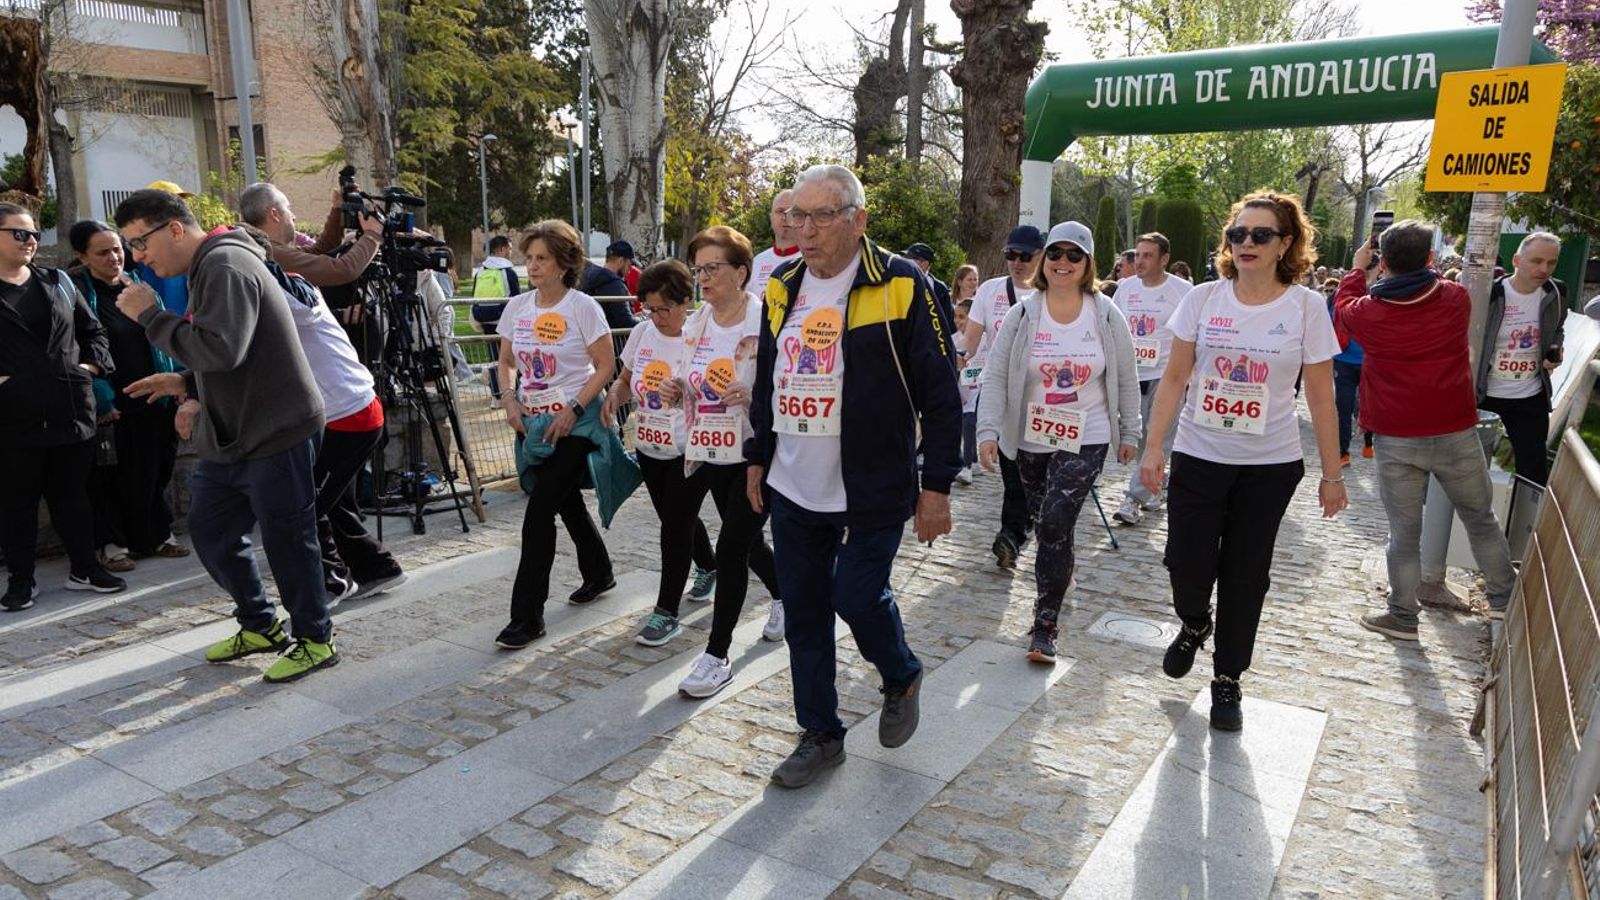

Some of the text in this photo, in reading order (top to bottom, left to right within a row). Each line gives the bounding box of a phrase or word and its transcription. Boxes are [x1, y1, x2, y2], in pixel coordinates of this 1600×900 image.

[1086, 52, 1437, 109] JUNTA DE ANDALUCIA
[1469, 80, 1529, 107] SALIDA
[1483, 116, 1506, 139] DE
[1443, 152, 1531, 175] CAMIONES
[1208, 316, 1232, 328] XXVII
[1499, 361, 1536, 372] 5083
[527, 402, 563, 415] 679
[779, 394, 835, 418] 5667
[1203, 394, 1261, 418] 5646
[637, 426, 672, 446] 5682
[691, 430, 736, 448] 5680
[1031, 418, 1079, 439] 5795
